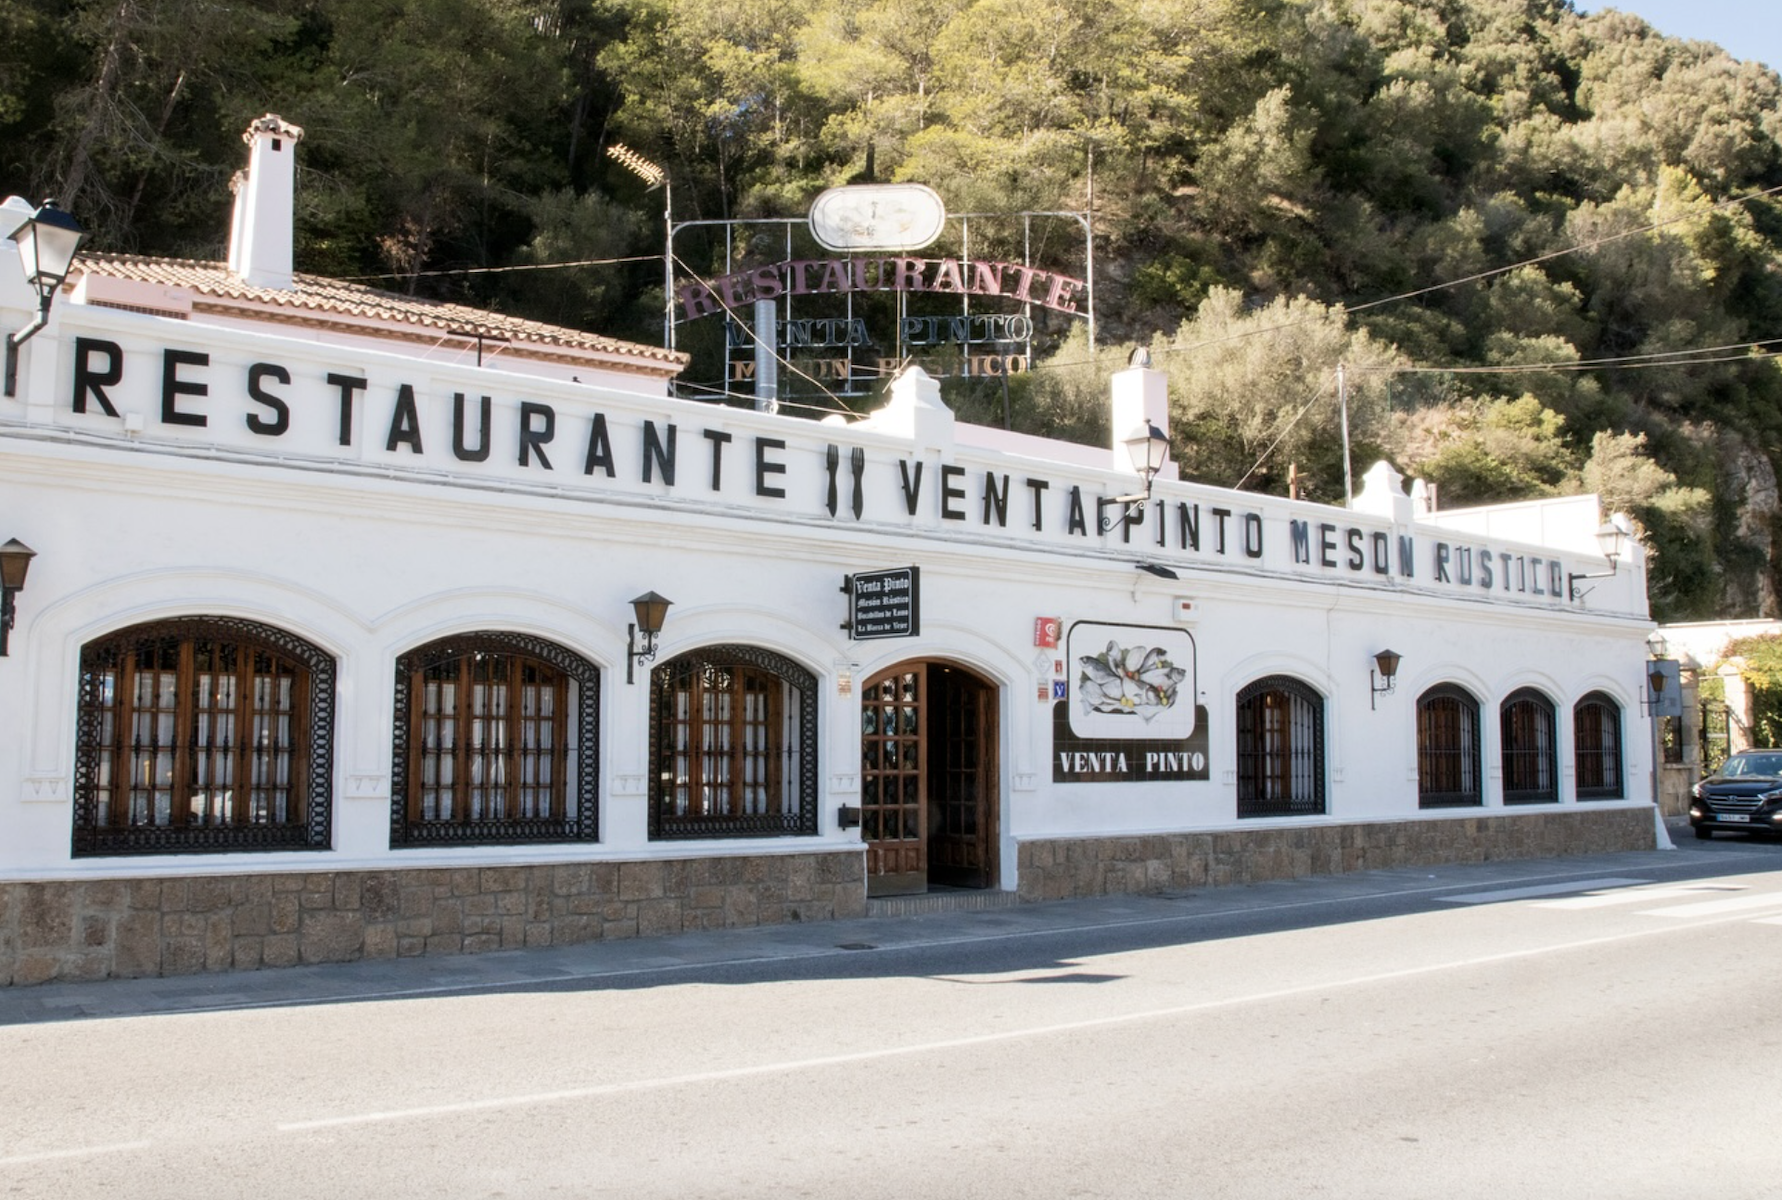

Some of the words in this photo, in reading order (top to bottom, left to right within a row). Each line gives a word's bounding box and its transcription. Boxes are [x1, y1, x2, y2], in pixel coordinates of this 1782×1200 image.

[680, 257, 1083, 321] RESTAURANTE
[900, 313, 1033, 345] PINTO
[73, 337, 785, 499] RESTAURANTE
[899, 459, 1087, 537] VENTA
[1124, 493, 1263, 559] PINTO
[1290, 519, 1414, 578] MESON
[1434, 542, 1563, 598] RUSTICO
[856, 580, 881, 594] Venta
[883, 577, 909, 593] Pinto
[1060, 752, 1128, 773] VENTA
[1146, 752, 1205, 772] PINTO
